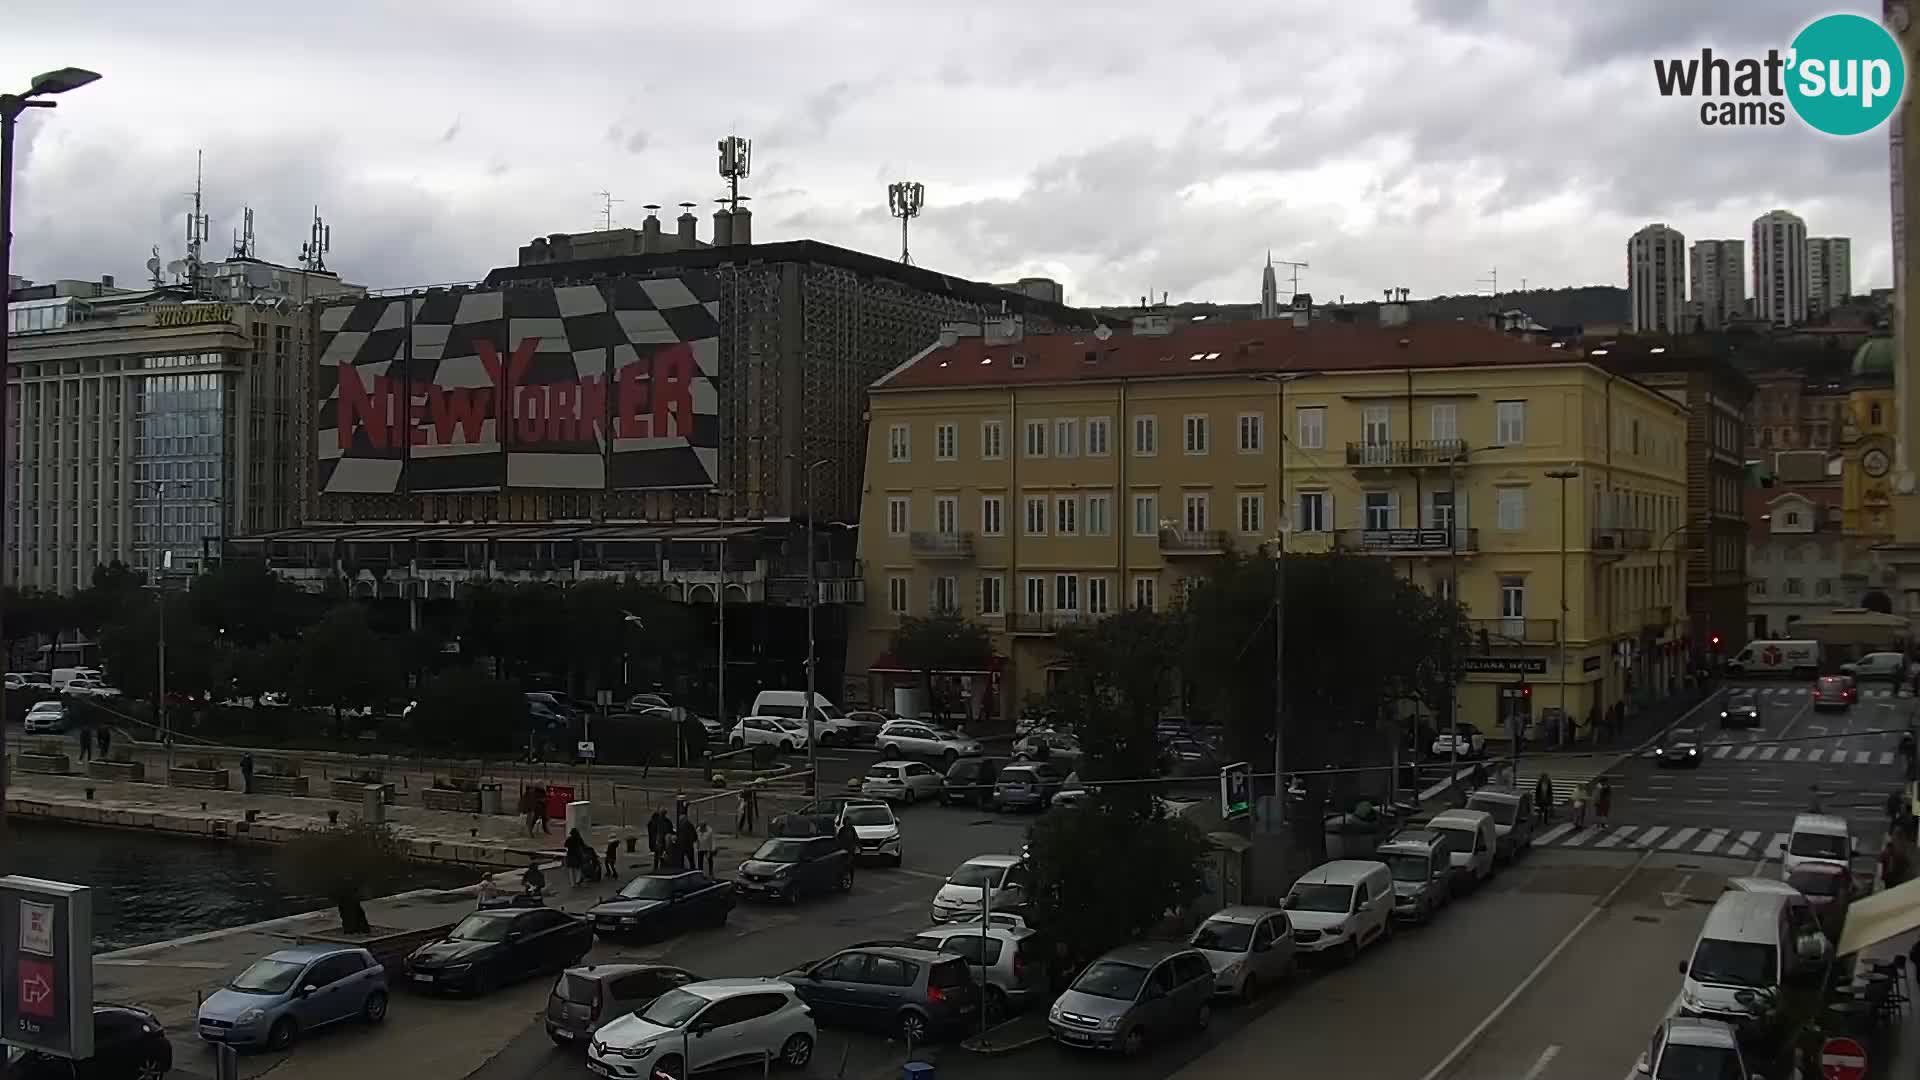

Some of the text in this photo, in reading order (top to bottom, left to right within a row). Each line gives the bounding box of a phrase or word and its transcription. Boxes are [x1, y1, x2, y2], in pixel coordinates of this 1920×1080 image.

[337, 337, 695, 449] NEW YORKER
[20, 1019, 40, 1033] 5 km
